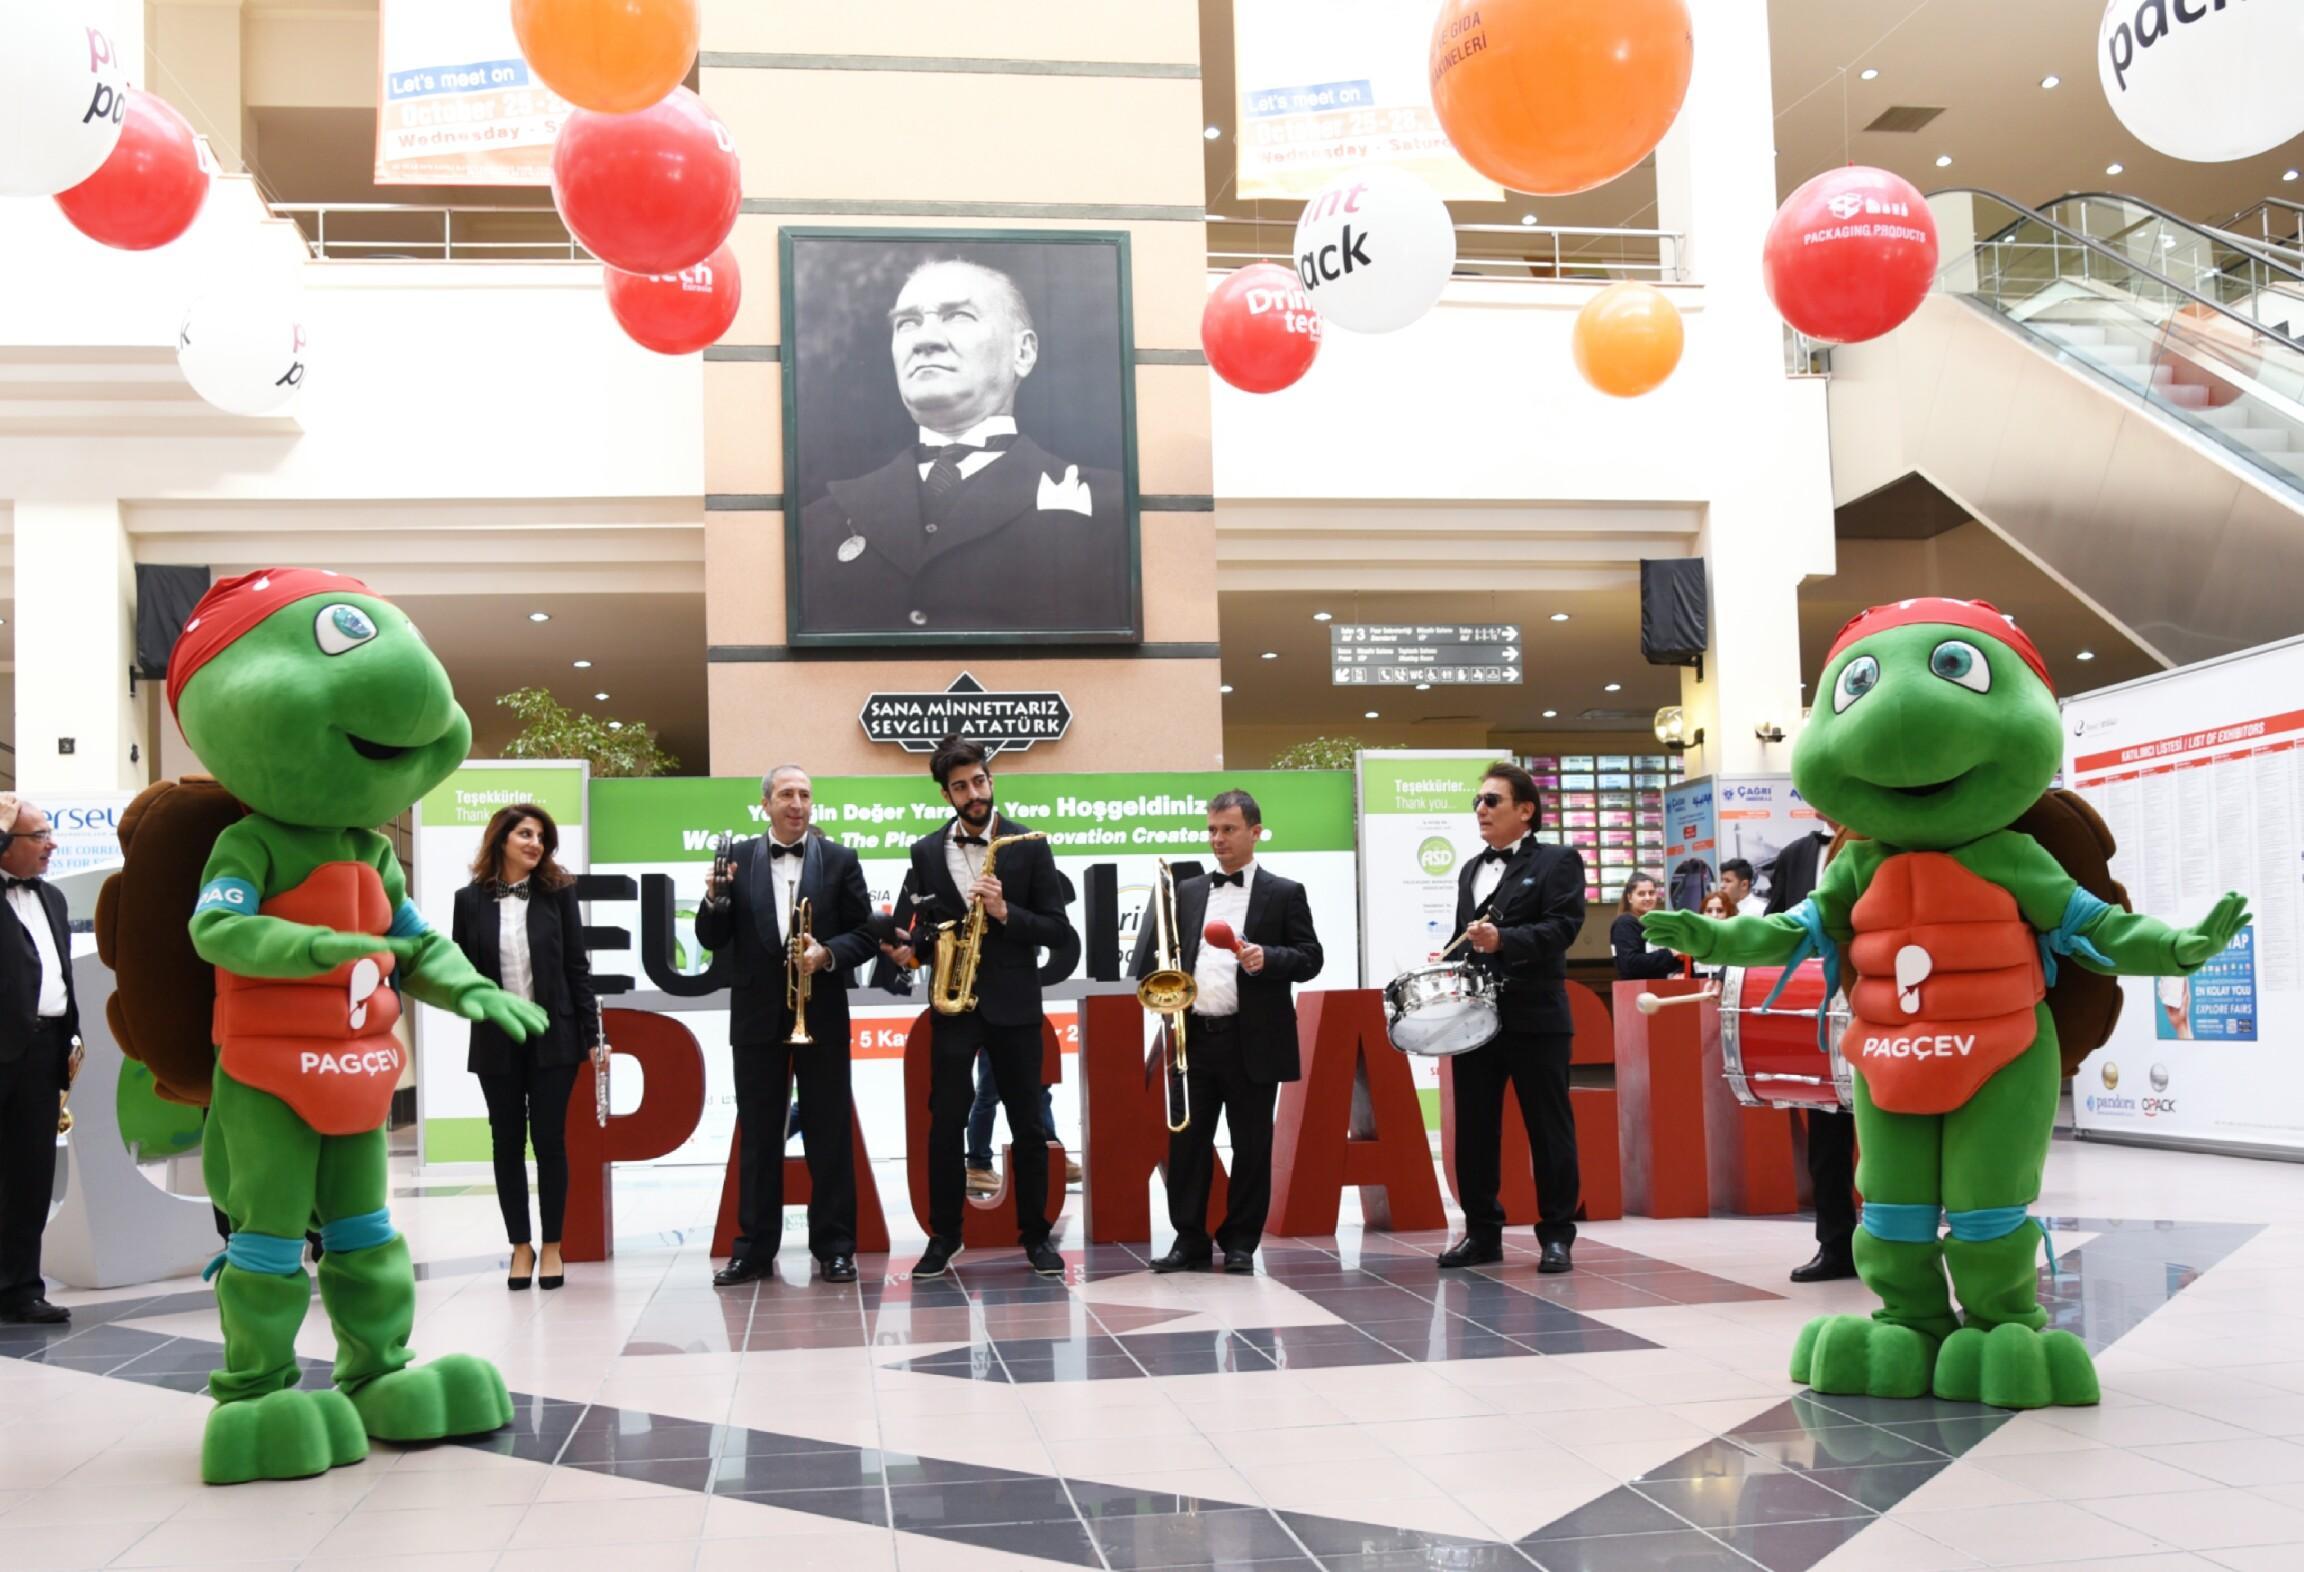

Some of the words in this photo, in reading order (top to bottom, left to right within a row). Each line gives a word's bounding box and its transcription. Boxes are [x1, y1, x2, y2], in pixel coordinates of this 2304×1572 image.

[1450, 12, 1481, 38] GIDA
[392, 73, 435, 94] Let's
[441, 68, 486, 88] meet
[492, 67, 515, 83] on
[1248, 94, 1287, 113] Let's
[1293, 91, 1334, 108] meet
[1340, 87, 1360, 102] on
[398, 126, 520, 149] Wednesday
[1803, 224, 1871, 246] PACKAGING
[1873, 223, 1926, 243] PRODUCTS
[1297, 224, 1372, 294] ack
[1357, 628, 1366, 641] 3
[1410, 670, 1424, 680] WC
[871, 701, 922, 716] SANA
[927, 699, 1059, 716] MİNNETTARIZ
[871, 719, 948, 734] SEVGİLİ
[961, 716, 1060, 734] ATATÜRK
[2206, 732, 2218, 744] OF
[1395, 796, 1426, 810] Thank
[457, 807, 490, 821] Thank
[844, 803, 904, 823] Değer
[1004, 801, 1051, 818] Yere
[841, 832, 879, 848] The
[2206, 985, 2231, 997] KOLAY
[2195, 1004, 2229, 1014] EXPLORE
[2230, 1004, 2252, 1014] FAIRS
[860, 1031, 872, 1047] 5
[1862, 1034, 1976, 1061] PAGÇEV
[301, 1049, 399, 1076] PAGÇEV
